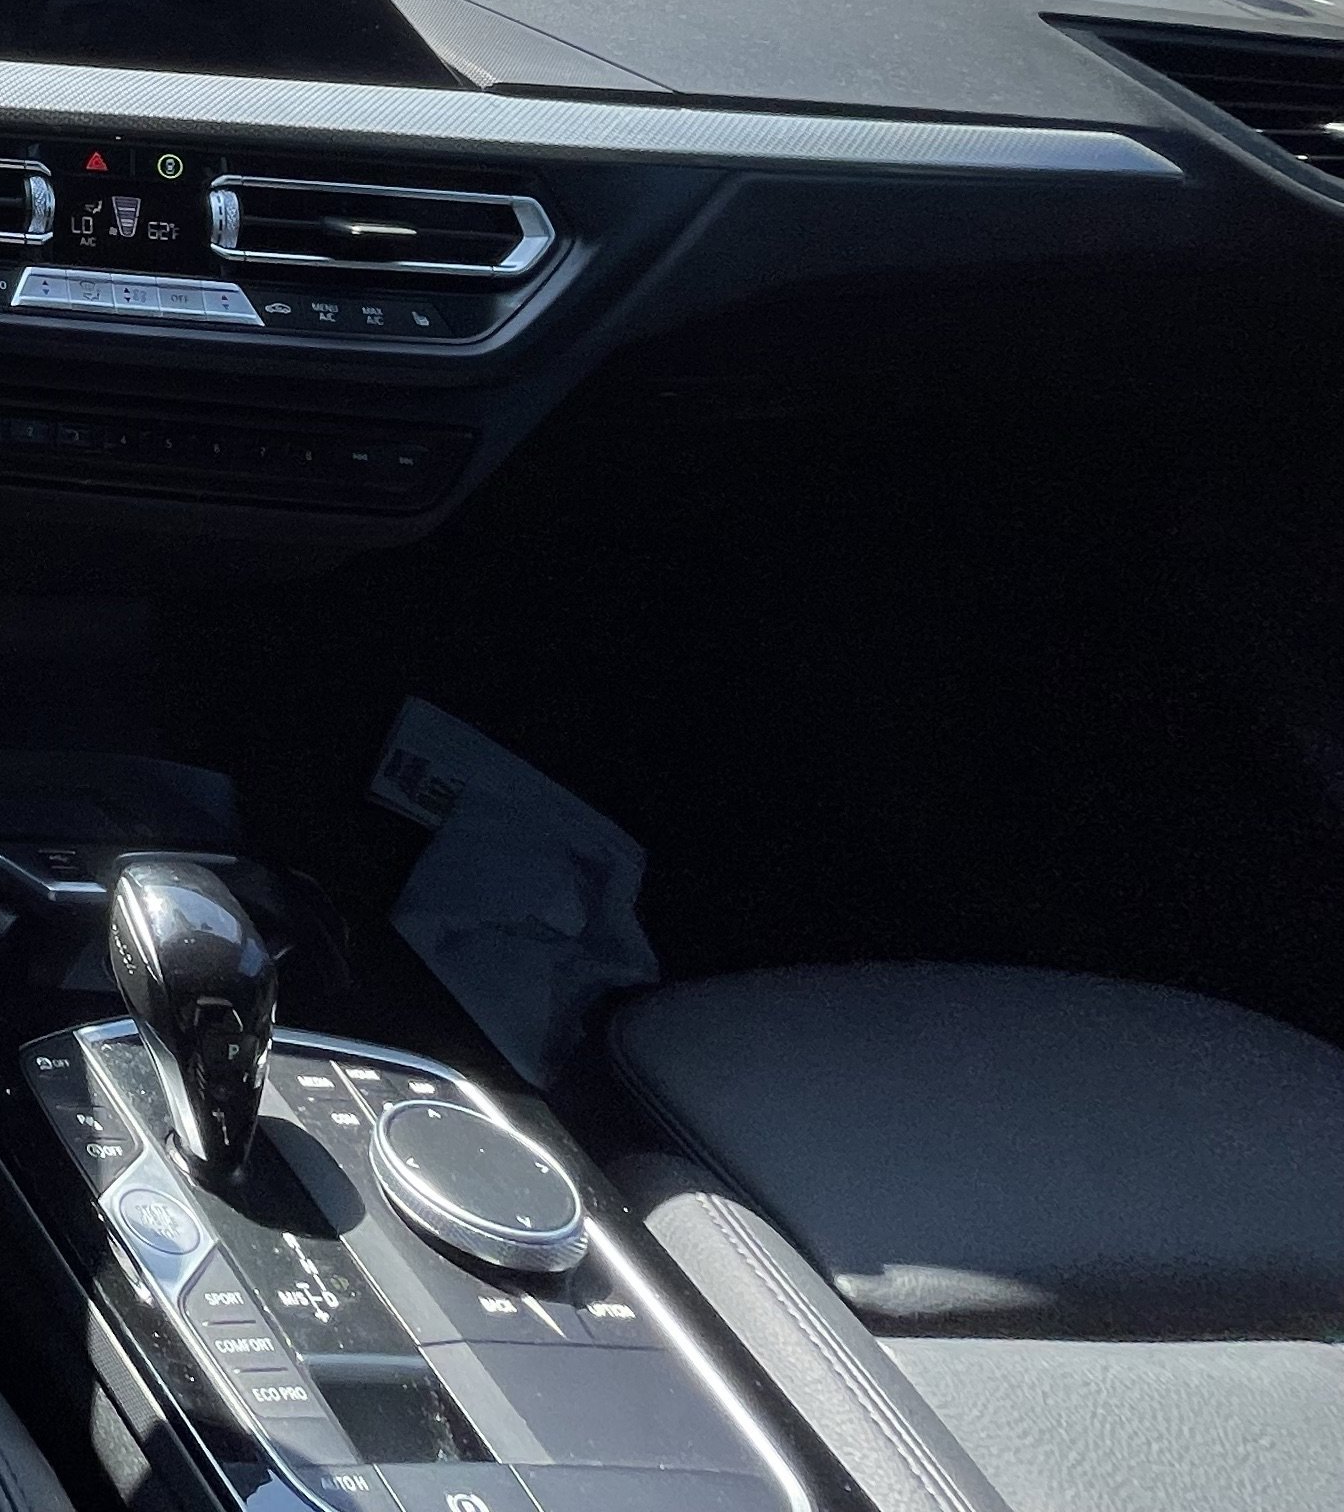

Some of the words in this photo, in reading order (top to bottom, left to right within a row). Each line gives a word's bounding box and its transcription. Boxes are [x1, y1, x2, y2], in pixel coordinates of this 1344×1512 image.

[227, 1043, 240, 1061] P
[204, 1291, 245, 1306] SPORT
[214, 1337, 276, 1354] COMFORT
[252, 1387, 281, 1402] ECO
[281, 1386, 309, 1402] PRO
